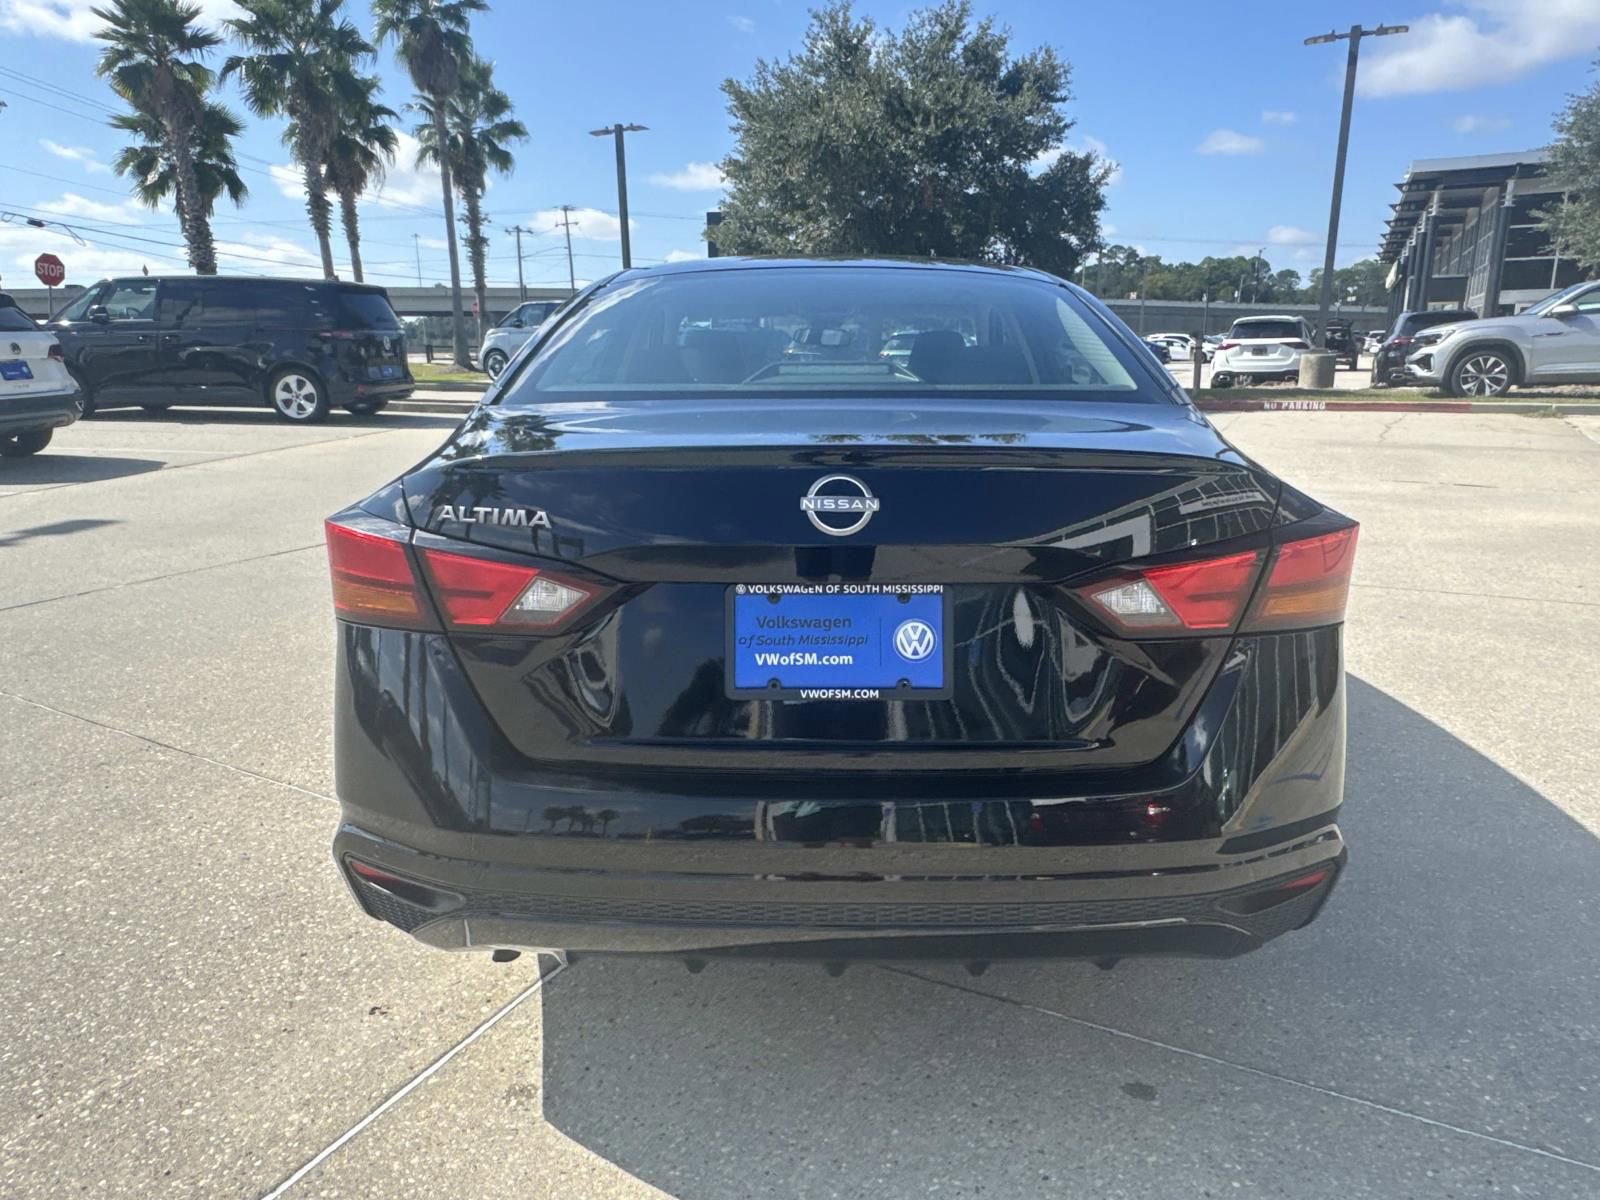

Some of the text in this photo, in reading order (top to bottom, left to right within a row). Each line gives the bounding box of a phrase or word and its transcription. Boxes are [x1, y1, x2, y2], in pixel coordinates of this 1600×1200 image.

[37, 262, 64, 278] STOP
[1263, 401, 1326, 410] NO PARKING
[802, 499, 877, 509] NISSAN
[437, 505, 552, 529] ALTIMA
[748, 584, 823, 594] VOLKSWAGEN
[826, 584, 840, 594] OF
[843, 584, 880, 594] SOUTH
[882, 584, 944, 594] MISSISSIPPI
[756, 616, 852, 631] Volkswagen
[738, 634, 868, 648] of South Mississippi
[755, 652, 853, 666] VWofSM.com
[800, 689, 880, 699] VWOFSM.COM
